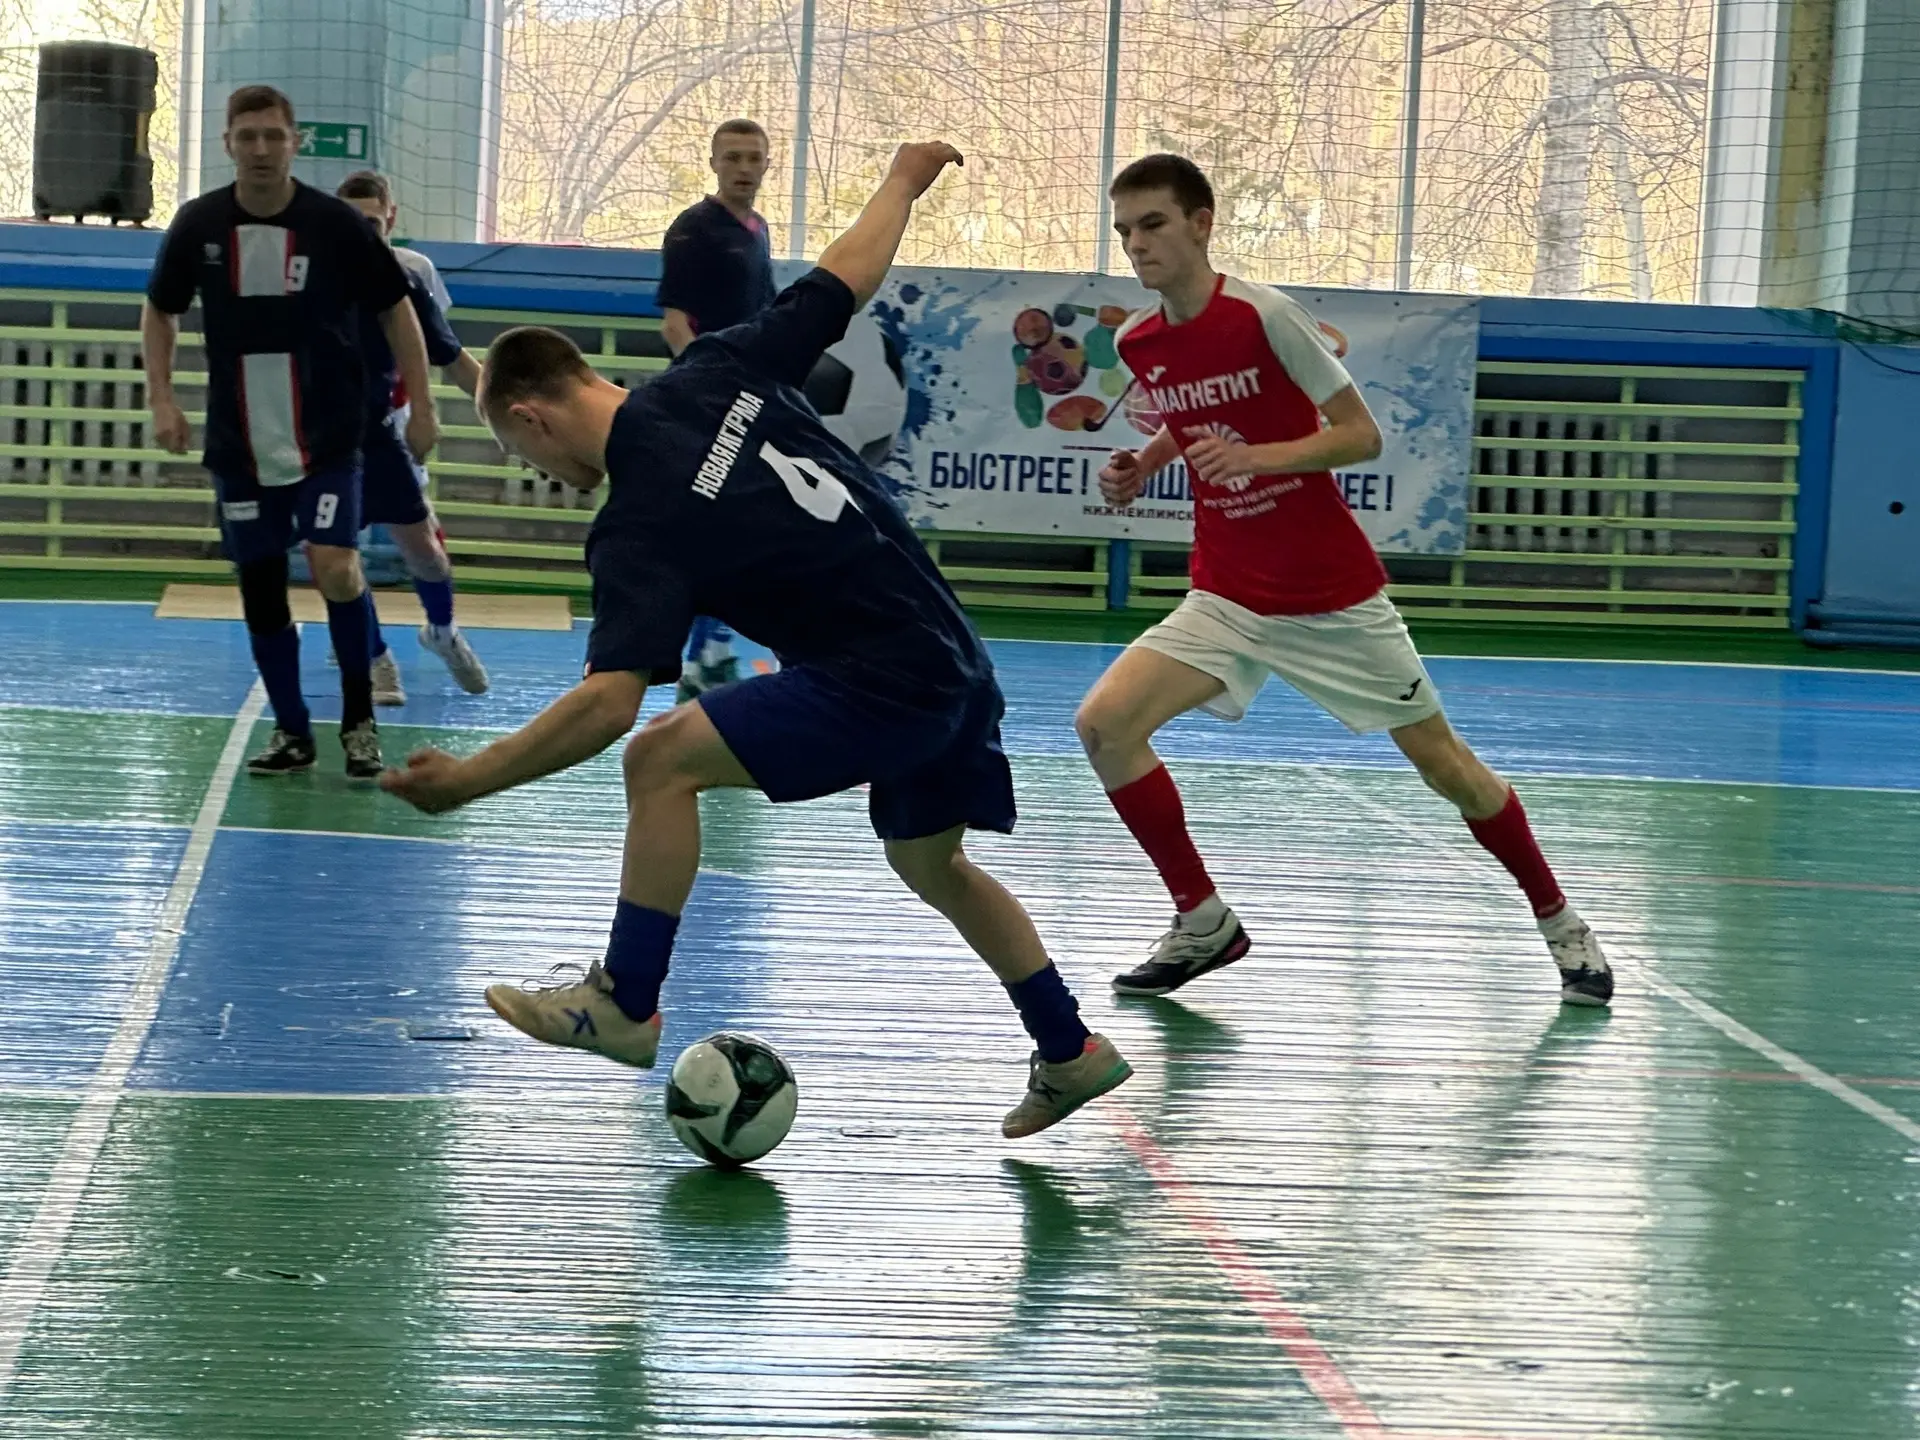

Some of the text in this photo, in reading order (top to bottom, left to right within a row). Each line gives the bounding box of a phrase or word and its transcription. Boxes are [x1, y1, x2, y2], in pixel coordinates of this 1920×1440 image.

[285, 256, 309, 291] 9
[1152, 367, 1263, 414] МАГНЕТИТ
[759, 440, 864, 523] 4
[1335, 473, 1394, 511] ЕЕ!
[314, 493, 339, 529] 9
